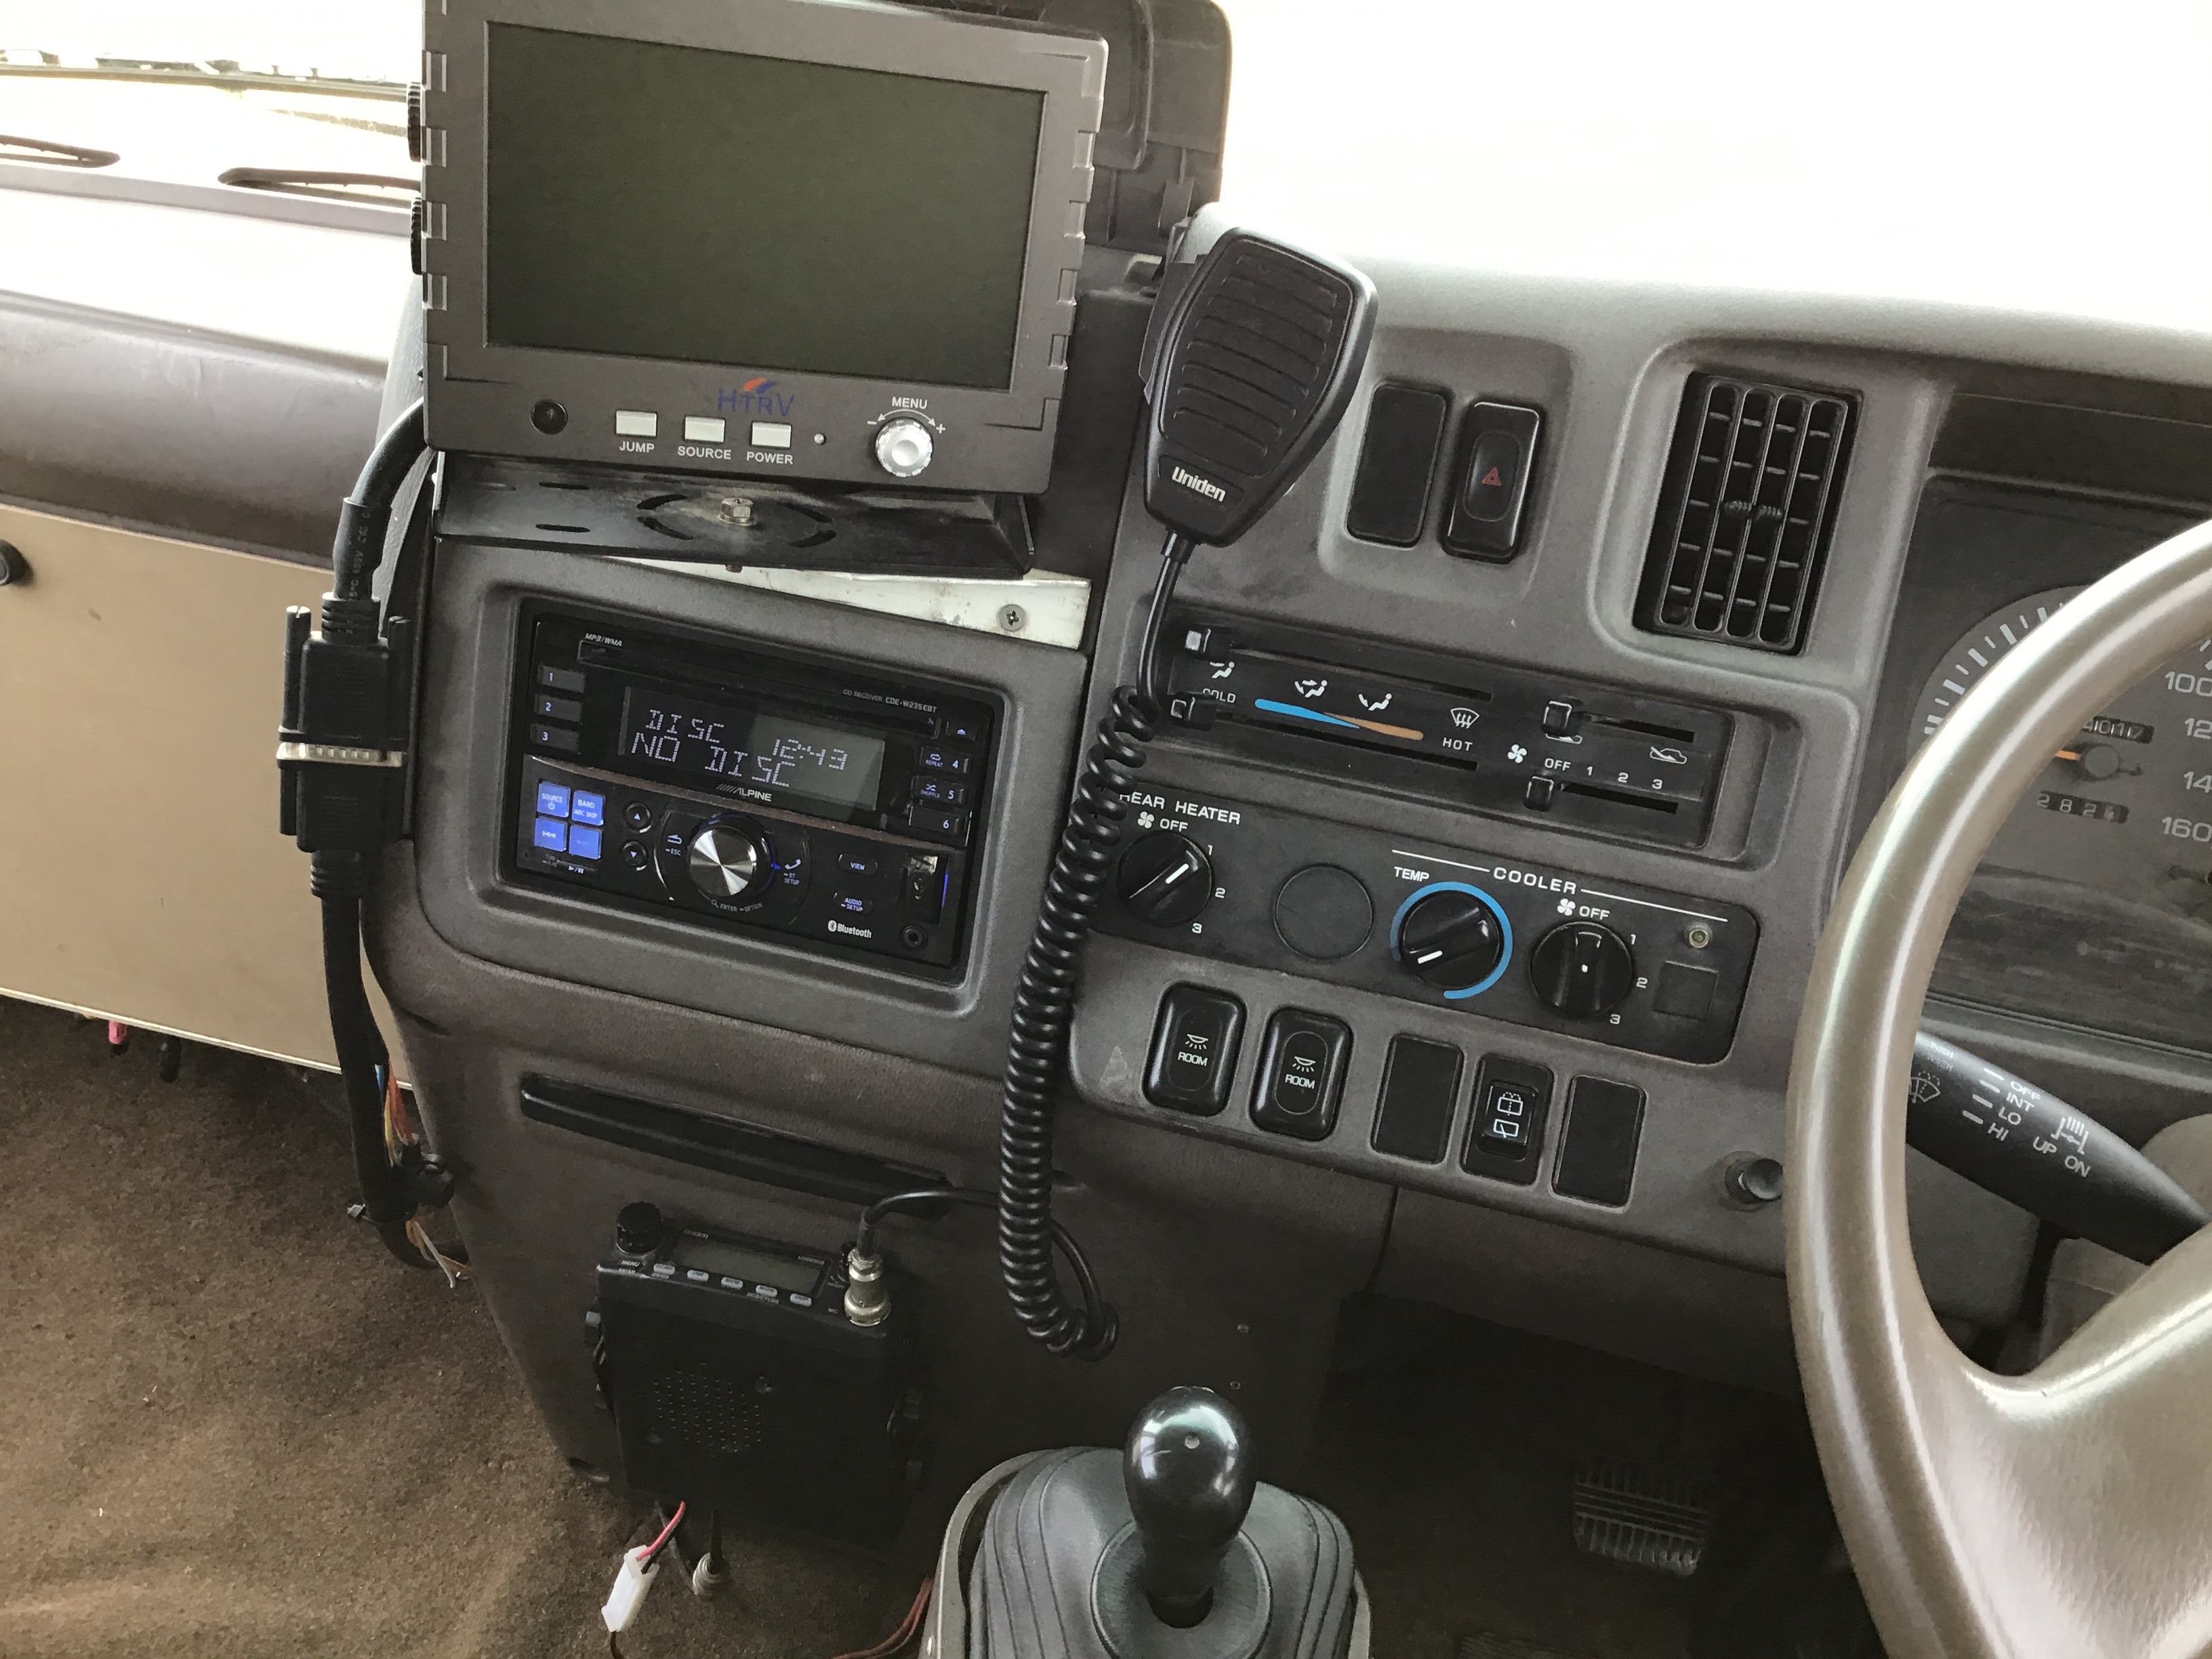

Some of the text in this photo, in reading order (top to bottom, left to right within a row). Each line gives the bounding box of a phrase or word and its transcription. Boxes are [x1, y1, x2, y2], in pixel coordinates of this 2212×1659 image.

[718, 386, 795, 417] HTRV
[892, 396, 928, 409] MENU
[619, 441, 655, 455] JUMP
[677, 445, 732, 461] SOURCE
[746, 451, 794, 465] POWER
[1172, 466, 1226, 502] Uniden
[548, 672, 554, 682] 1
[2165, 671, 2212, 697] 100
[545, 702, 552, 712] 2
[646, 710, 725, 743] DISC
[542, 731, 548, 741] 3
[1442, 737, 1473, 752] HOT
[631, 732, 796, 787] NO DISC
[773, 739, 848, 771] 12:43
[952, 760, 959, 769] 4
[1544, 757, 1663, 790] OFF 1 2 3
[731, 786, 772, 802] ALPINE
[947, 790, 954, 800] 5
[1175, 800, 1241, 825] HEATER
[943, 819, 949, 829] 6
[1160, 818, 1188, 832] OFF
[2162, 816, 2212, 842] 160
[1208, 844, 1213, 856] 1
[851, 861, 865, 871] VIEW
[1393, 865, 1430, 882] TEMP
[1493, 867, 1577, 895] COOLER
[1214, 887, 1226, 899] 2
[844, 897, 863, 906] AUDIO
[846, 903, 863, 912] SETUP
[1579, 906, 1611, 920] OFF
[837, 922, 872, 939] Bluetooth
[1191, 922, 1202, 934] 3
[1630, 934, 1636, 945] 1
[1636, 977, 1648, 988] 2
[1610, 1013, 1621, 1025] 3
[1178, 1051, 1208, 1067] ROOM
[1285, 1073, 1315, 1089] ROOM
[2010, 1081, 2041, 1101] OFF
[2006, 1092, 2034, 1112] INT
[1999, 1106, 2022, 1126] LO
[1988, 1122, 2009, 1141] HI
[2032, 1136, 2057, 1154] UP
[2064, 1155, 2091, 1178] ON
